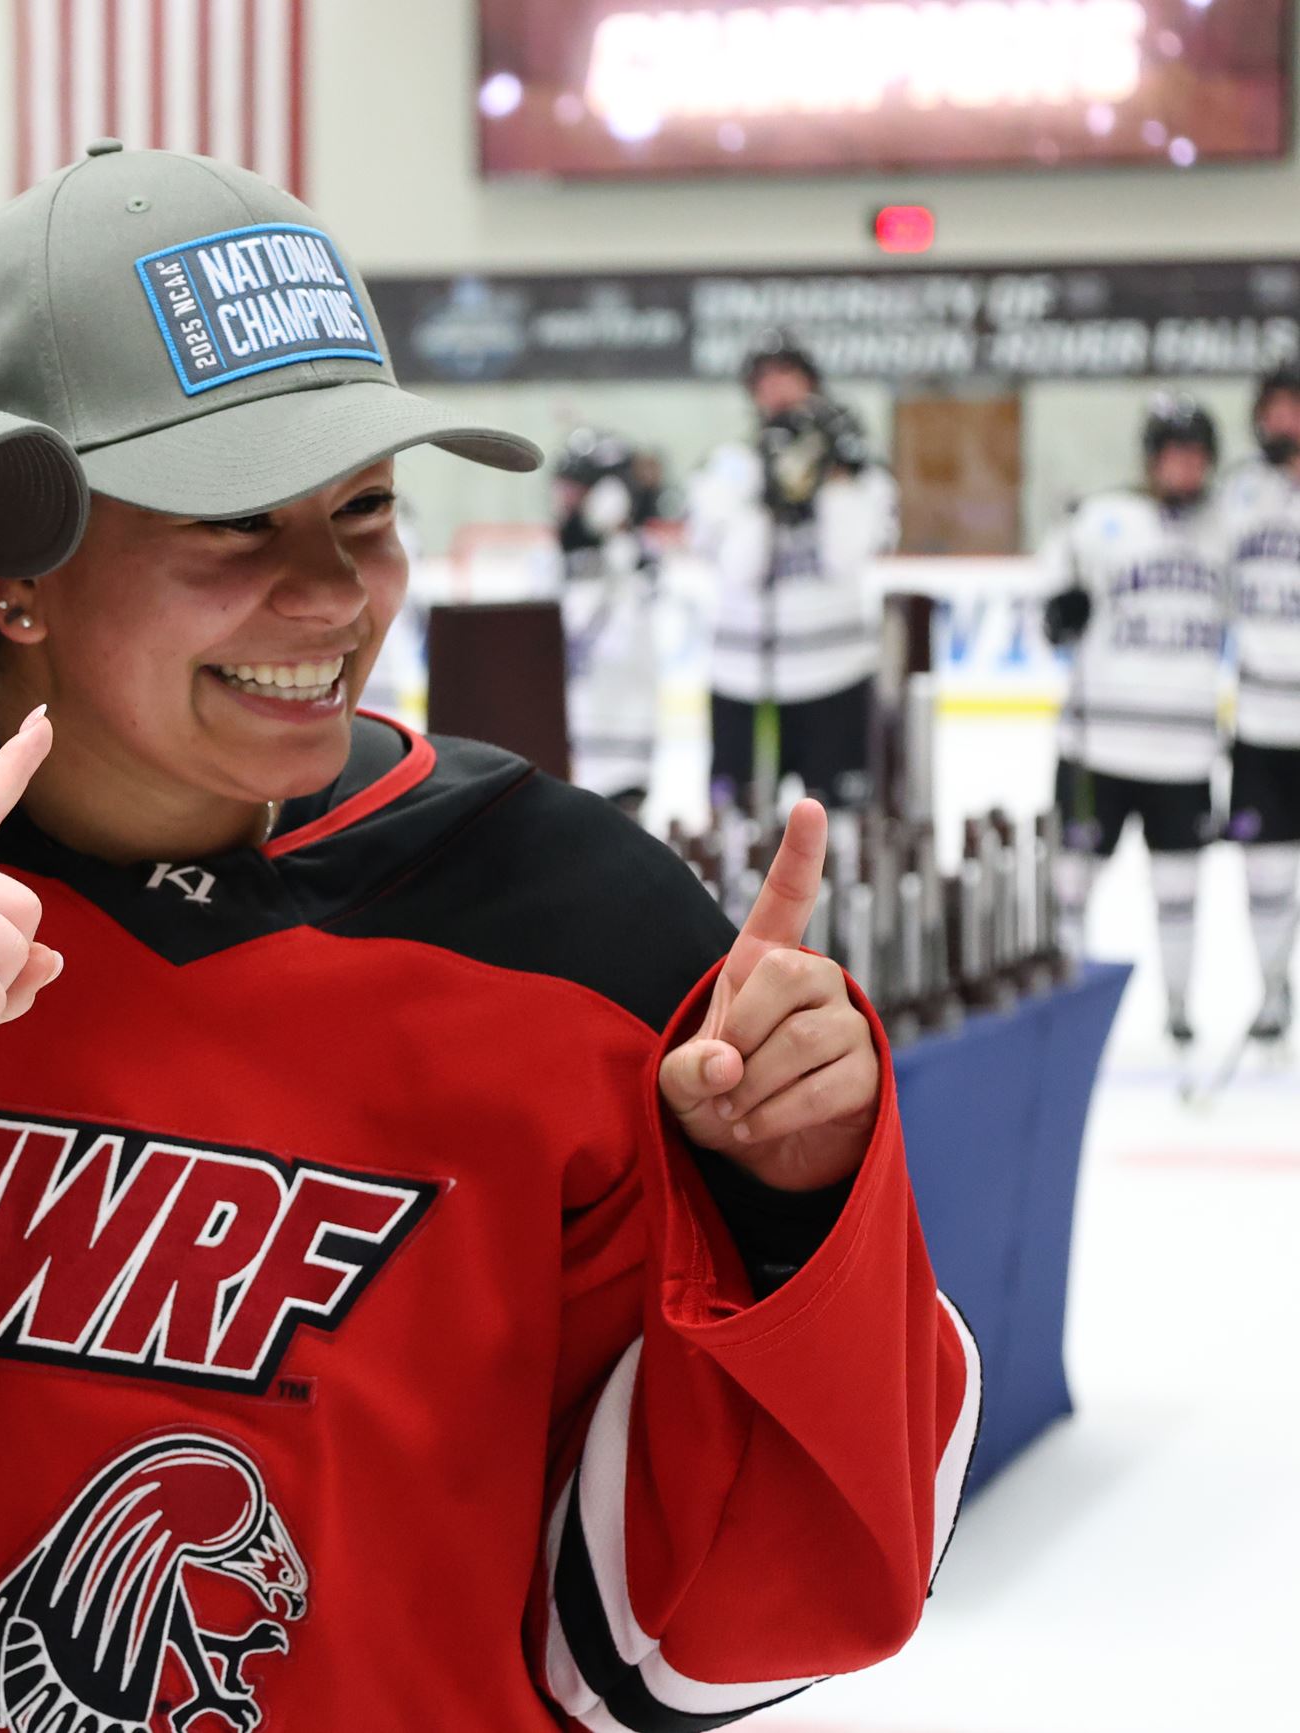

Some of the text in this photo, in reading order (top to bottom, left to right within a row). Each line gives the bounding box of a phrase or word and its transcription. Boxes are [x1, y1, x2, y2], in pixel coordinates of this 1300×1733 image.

[198, 235, 345, 299] NATIONAL
[180, 318, 217, 370] 2025
[217, 289, 367, 357] CHAMPIONS
